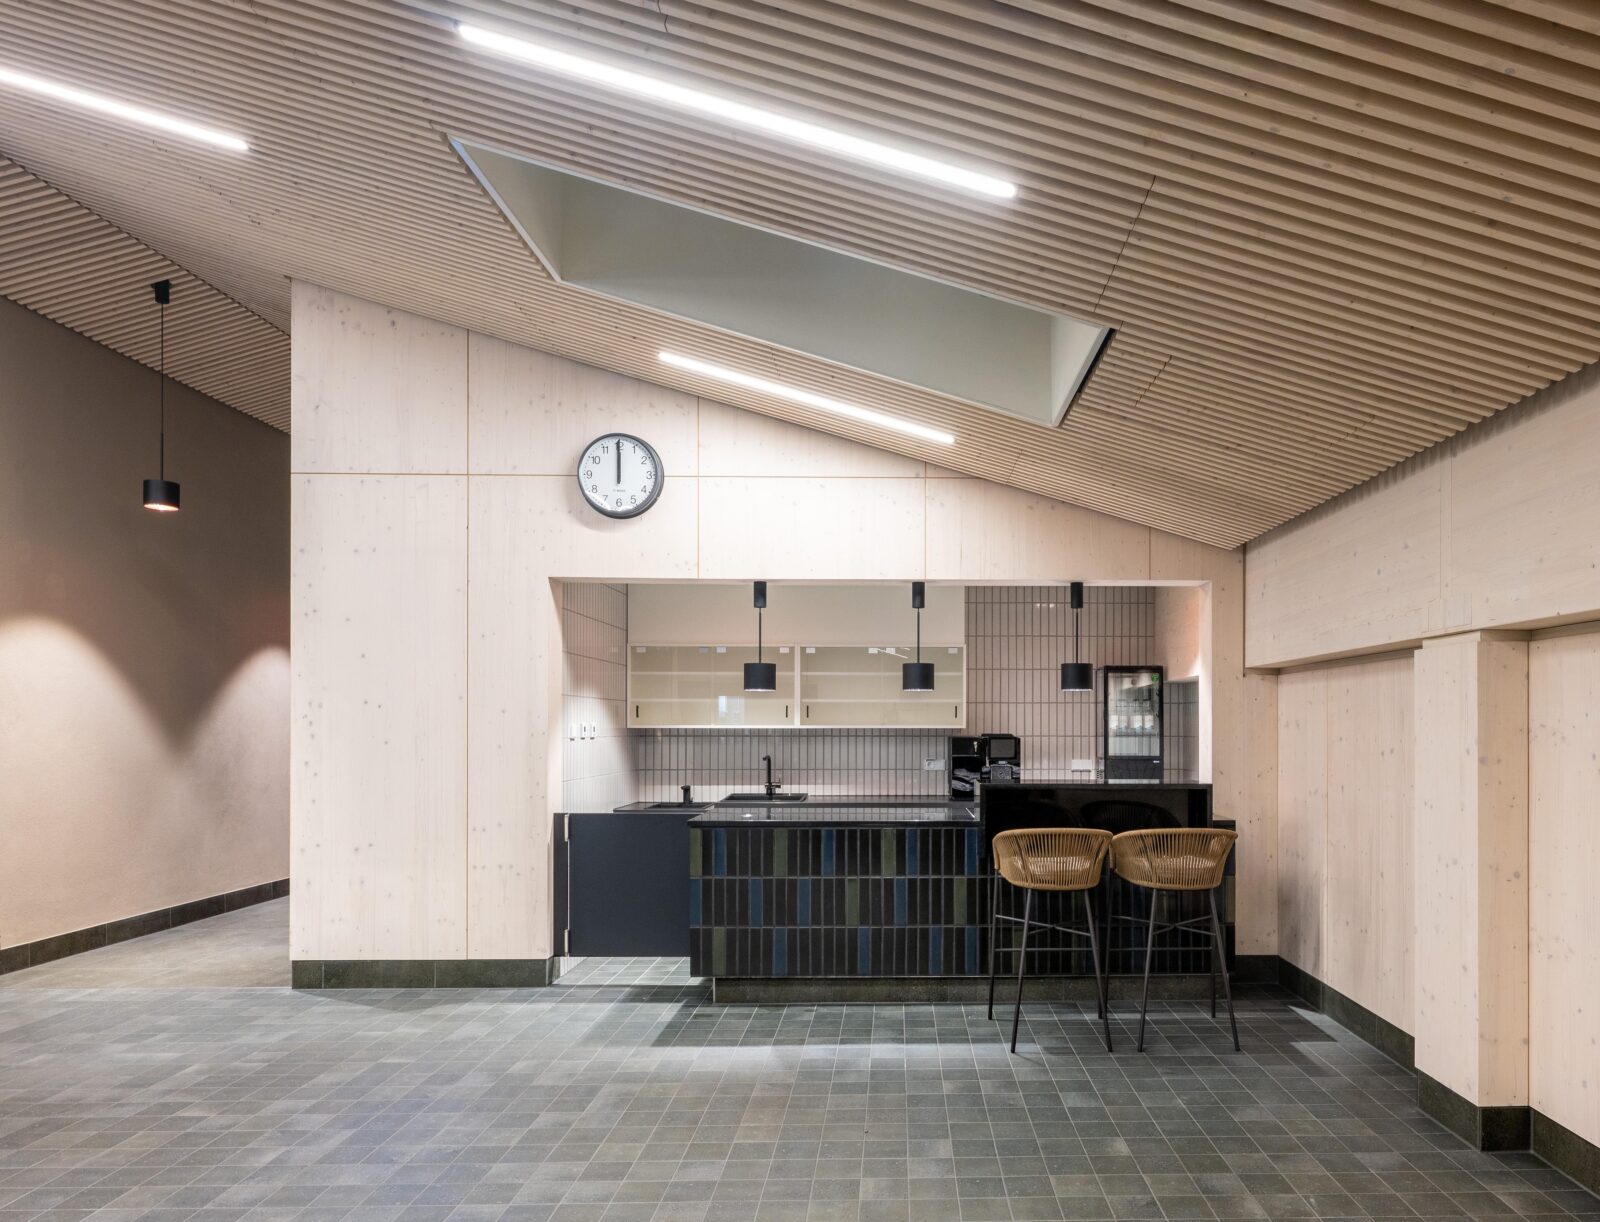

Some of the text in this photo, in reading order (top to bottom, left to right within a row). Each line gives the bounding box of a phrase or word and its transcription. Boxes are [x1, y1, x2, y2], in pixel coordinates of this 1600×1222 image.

[601, 446, 608, 454] 11
[632, 446, 636, 454] 1
[592, 456, 600, 464] 10
[641, 456, 647, 464] 2
[586, 470, 592, 479] 9
[646, 471, 652, 480] 3
[591, 485, 598, 493] 8
[641, 485, 647, 493] 4
[616, 498, 622, 507] 6
[630, 495, 636, 504] 5
